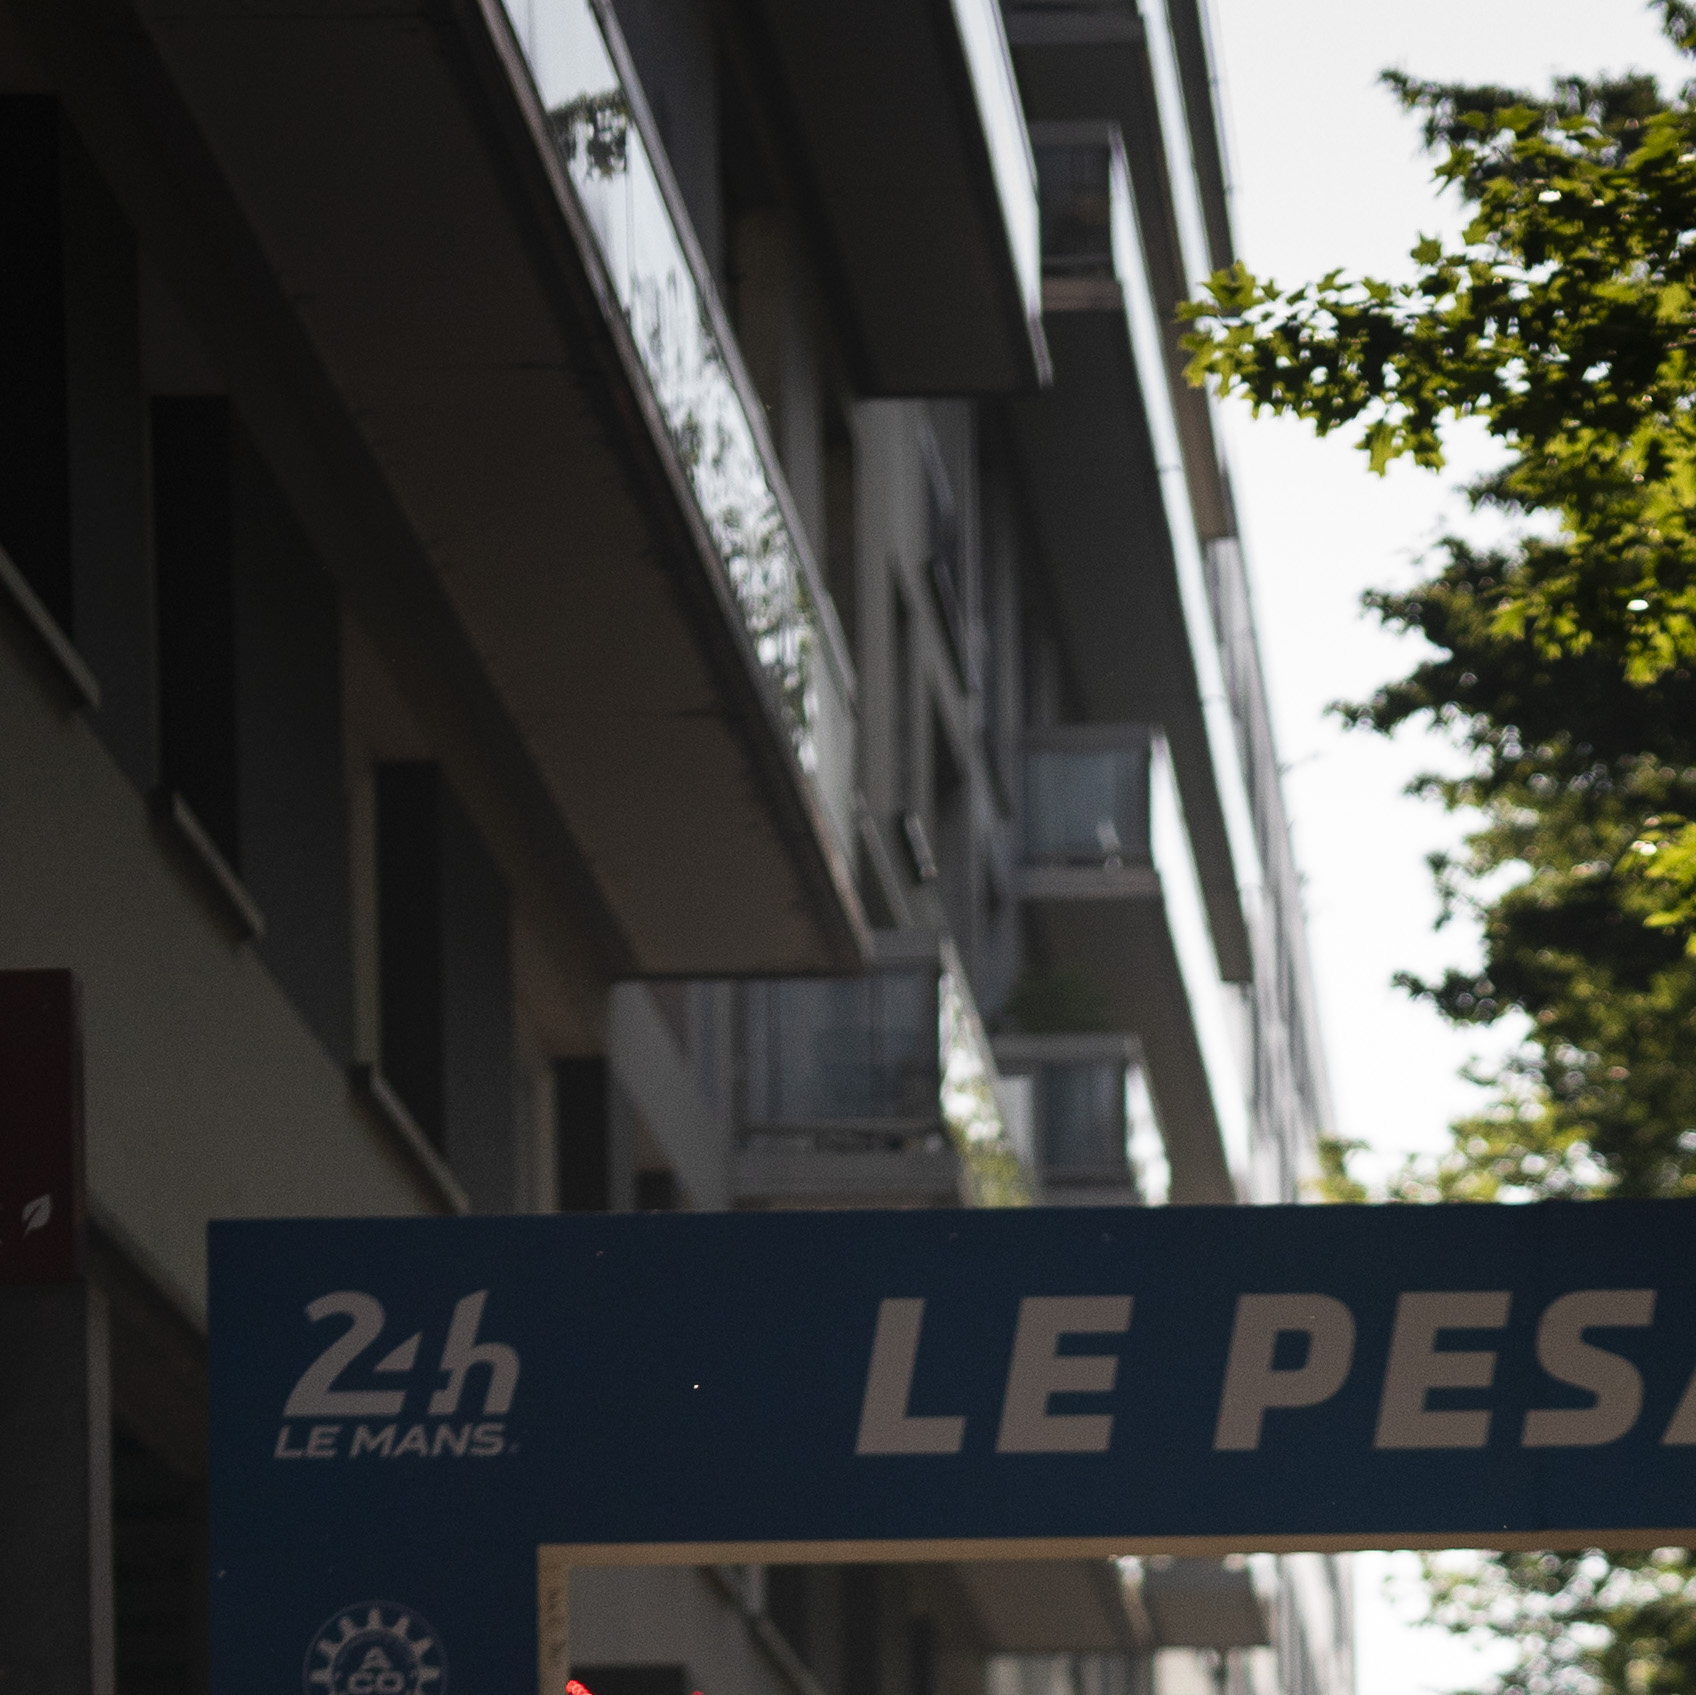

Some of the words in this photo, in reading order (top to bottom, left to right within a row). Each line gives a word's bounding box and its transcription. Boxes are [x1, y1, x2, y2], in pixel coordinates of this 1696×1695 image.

[281, 1288, 521, 1418] 24h
[854, 1294, 1135, 1457] LE
[273, 1423, 339, 1460] LE
[347, 1421, 507, 1459] MANS
